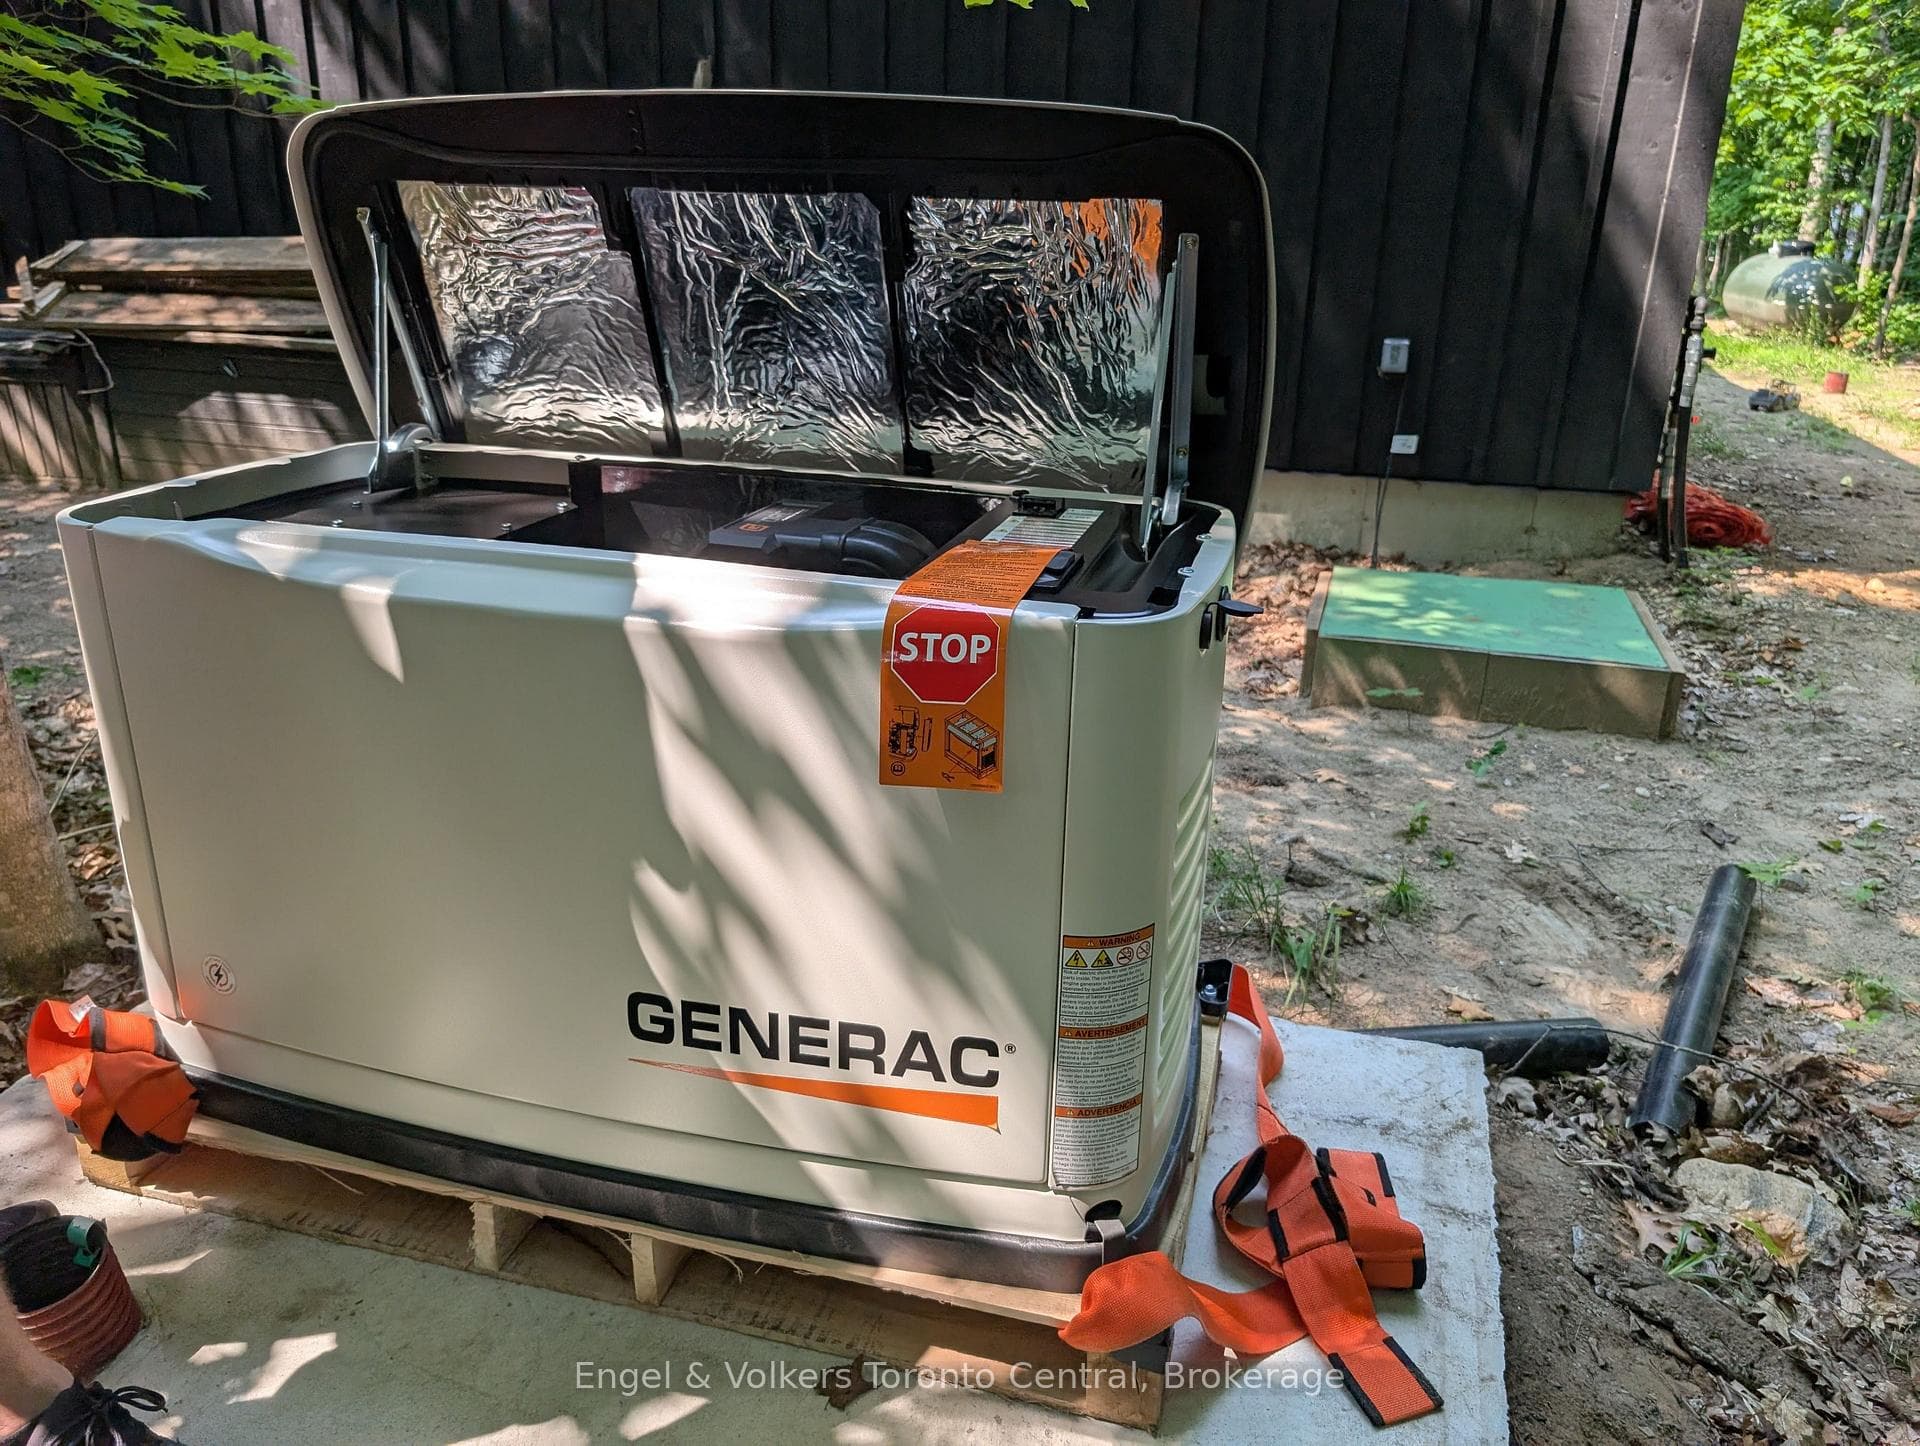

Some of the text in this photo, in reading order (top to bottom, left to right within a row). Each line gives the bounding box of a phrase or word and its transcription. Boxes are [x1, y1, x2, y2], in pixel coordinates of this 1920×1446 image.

[900, 632, 992, 664] STOP
[1099, 932, 1140, 946] WARNING
[1075, 1019, 1145, 1037] AVERTISSEMENT
[1077, 1098, 1137, 1117] ADVERTENCIA
